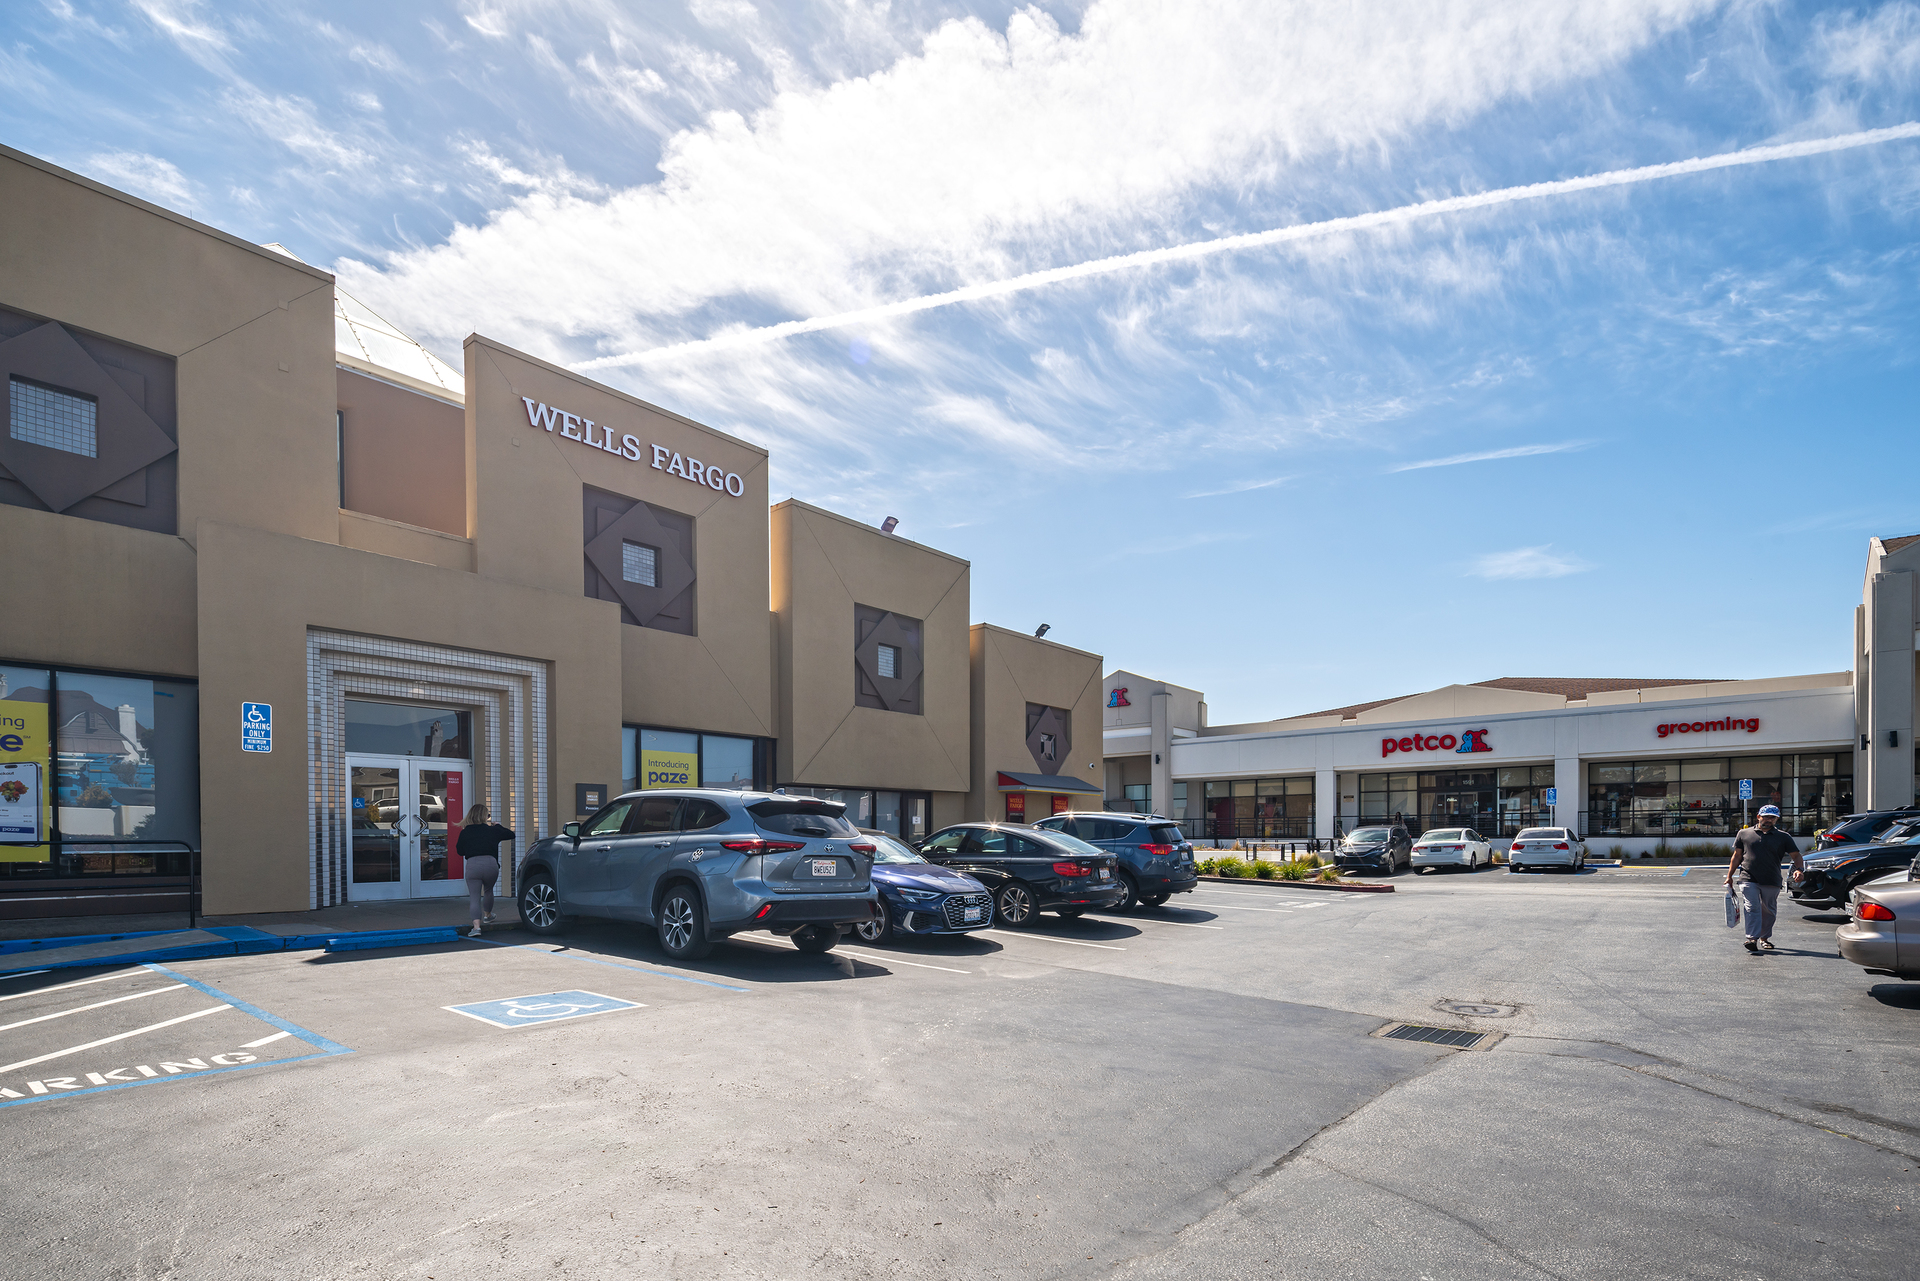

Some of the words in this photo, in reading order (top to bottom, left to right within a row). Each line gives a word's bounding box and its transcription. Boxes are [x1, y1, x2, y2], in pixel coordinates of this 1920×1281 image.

[521, 396, 641, 462] WELLS
[650, 443, 745, 498] FARGO
[243, 721, 271, 731] PARKING
[1656, 716, 1760, 739] grooming
[1381, 733, 1457, 758] petco
[648, 759, 689, 771] Introducing
[648, 771, 689, 786] paze
